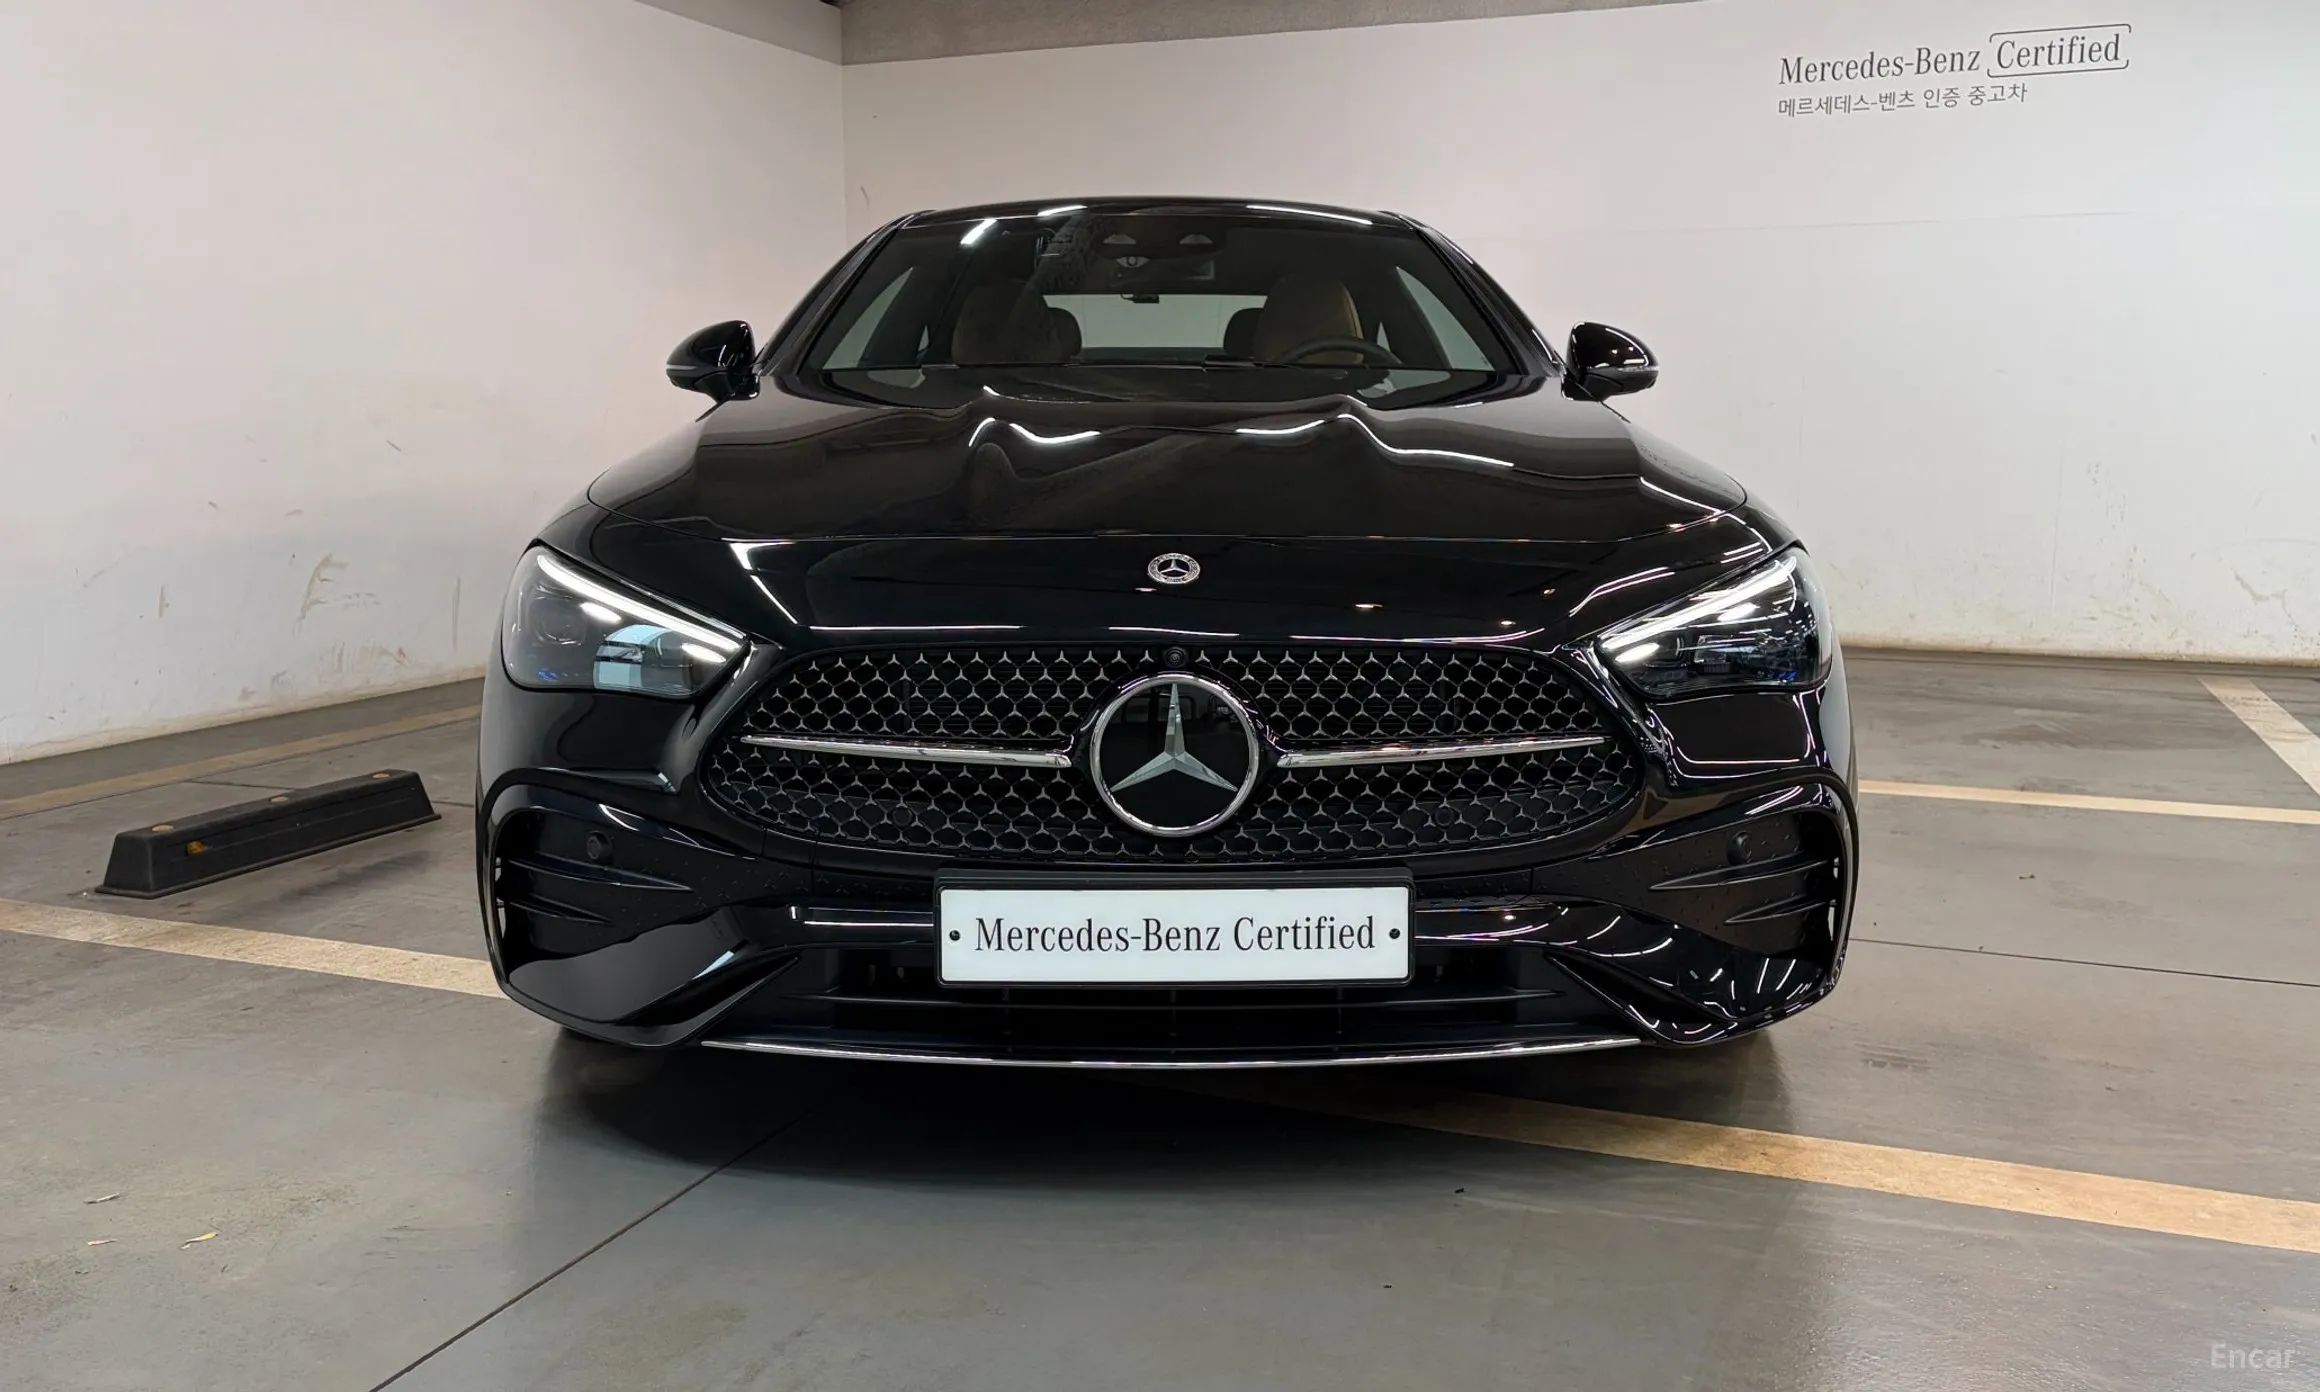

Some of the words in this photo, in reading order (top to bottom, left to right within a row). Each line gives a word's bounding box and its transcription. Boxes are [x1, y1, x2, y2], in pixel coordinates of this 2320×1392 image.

[1778, 46, 1981, 85] Mercedes-Benz
[1996, 33, 2121, 70] Certified
[1777, 91, 1916, 118] 메르세데스-벤츠
[1922, 87, 1961, 109] 인증
[1967, 83, 2028, 106] 중고차
[974, 917, 1221, 952] Mercedes-Benz
[1233, 915, 1376, 951] Certified
